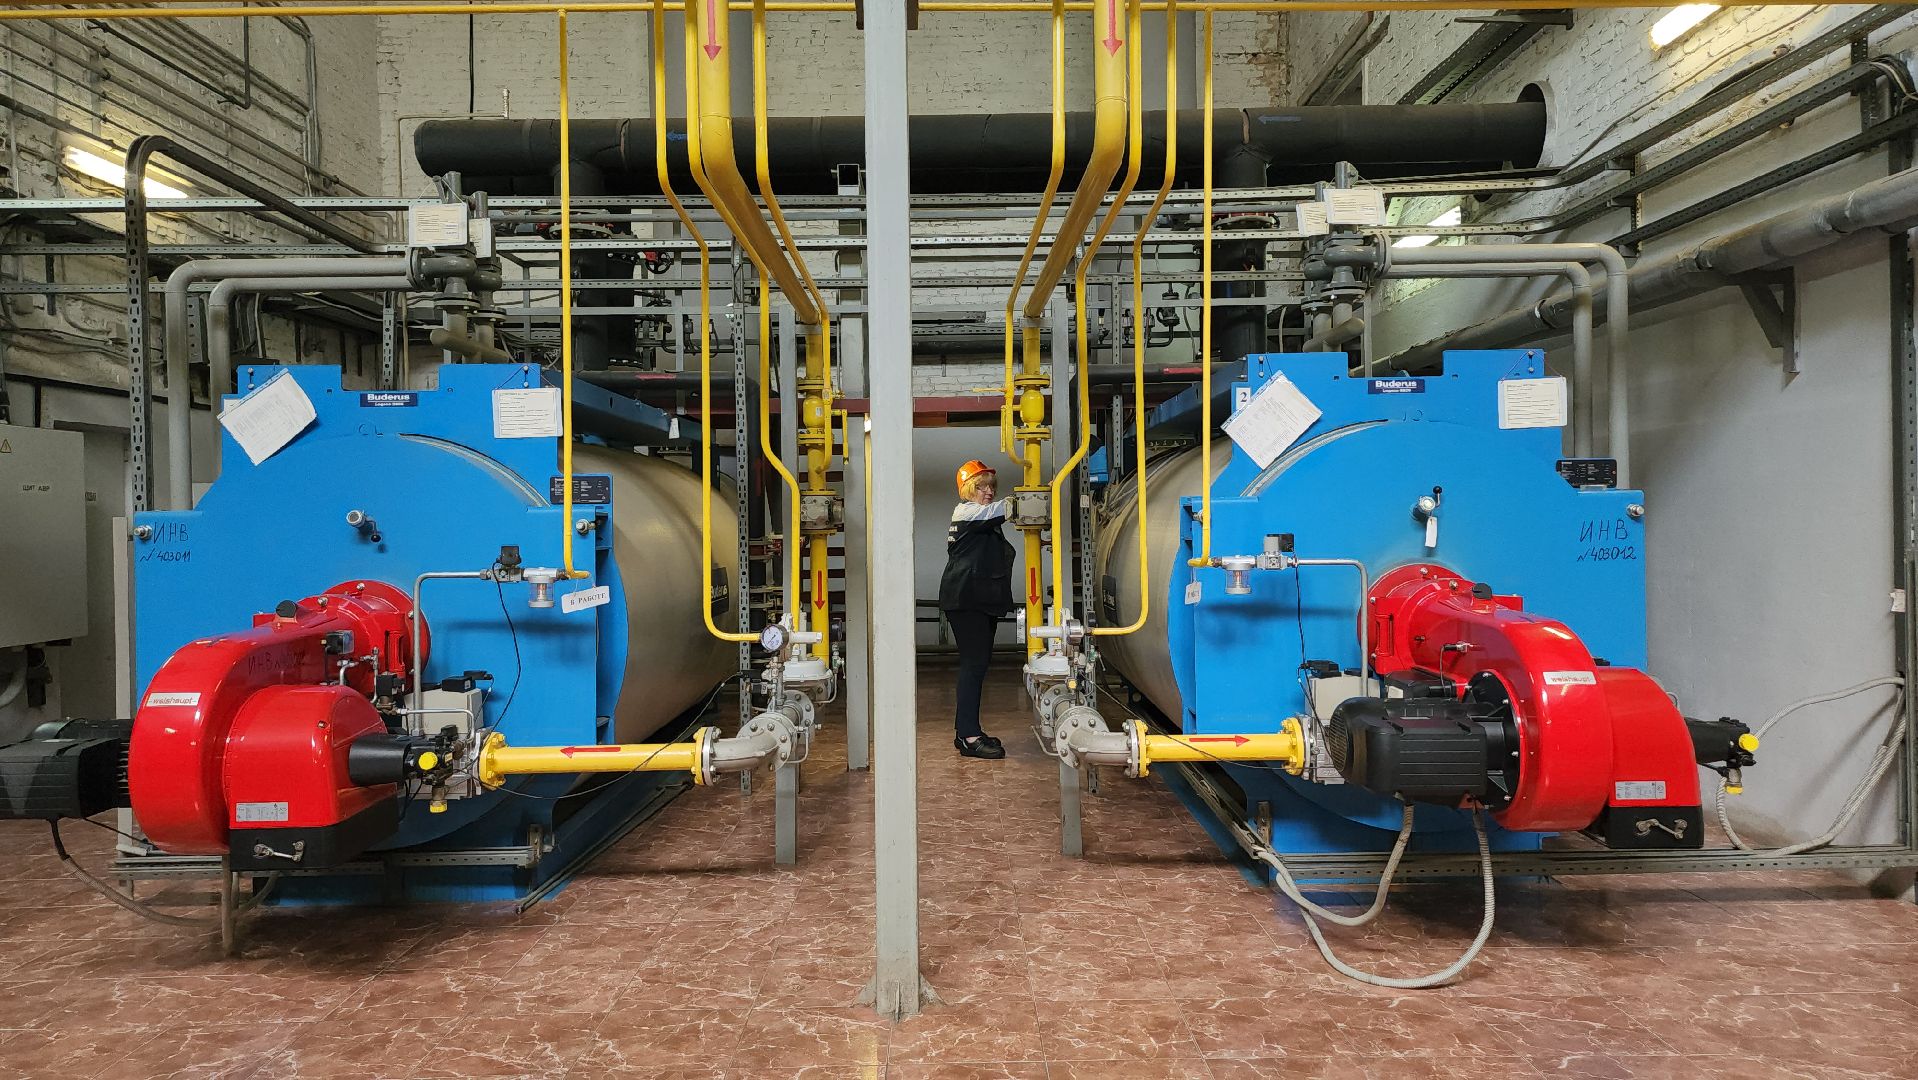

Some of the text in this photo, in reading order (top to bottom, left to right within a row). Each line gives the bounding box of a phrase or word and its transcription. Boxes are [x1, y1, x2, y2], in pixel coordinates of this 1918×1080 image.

[1375, 380, 1418, 388] Buderus
[367, 393, 411, 401] Buderus
[1239, 391, 1248, 403] 2
[153, 521, 189, 544] ИНВ
[1580, 519, 1628, 542] ИНВ
[152, 695, 193, 705] weishaupt
